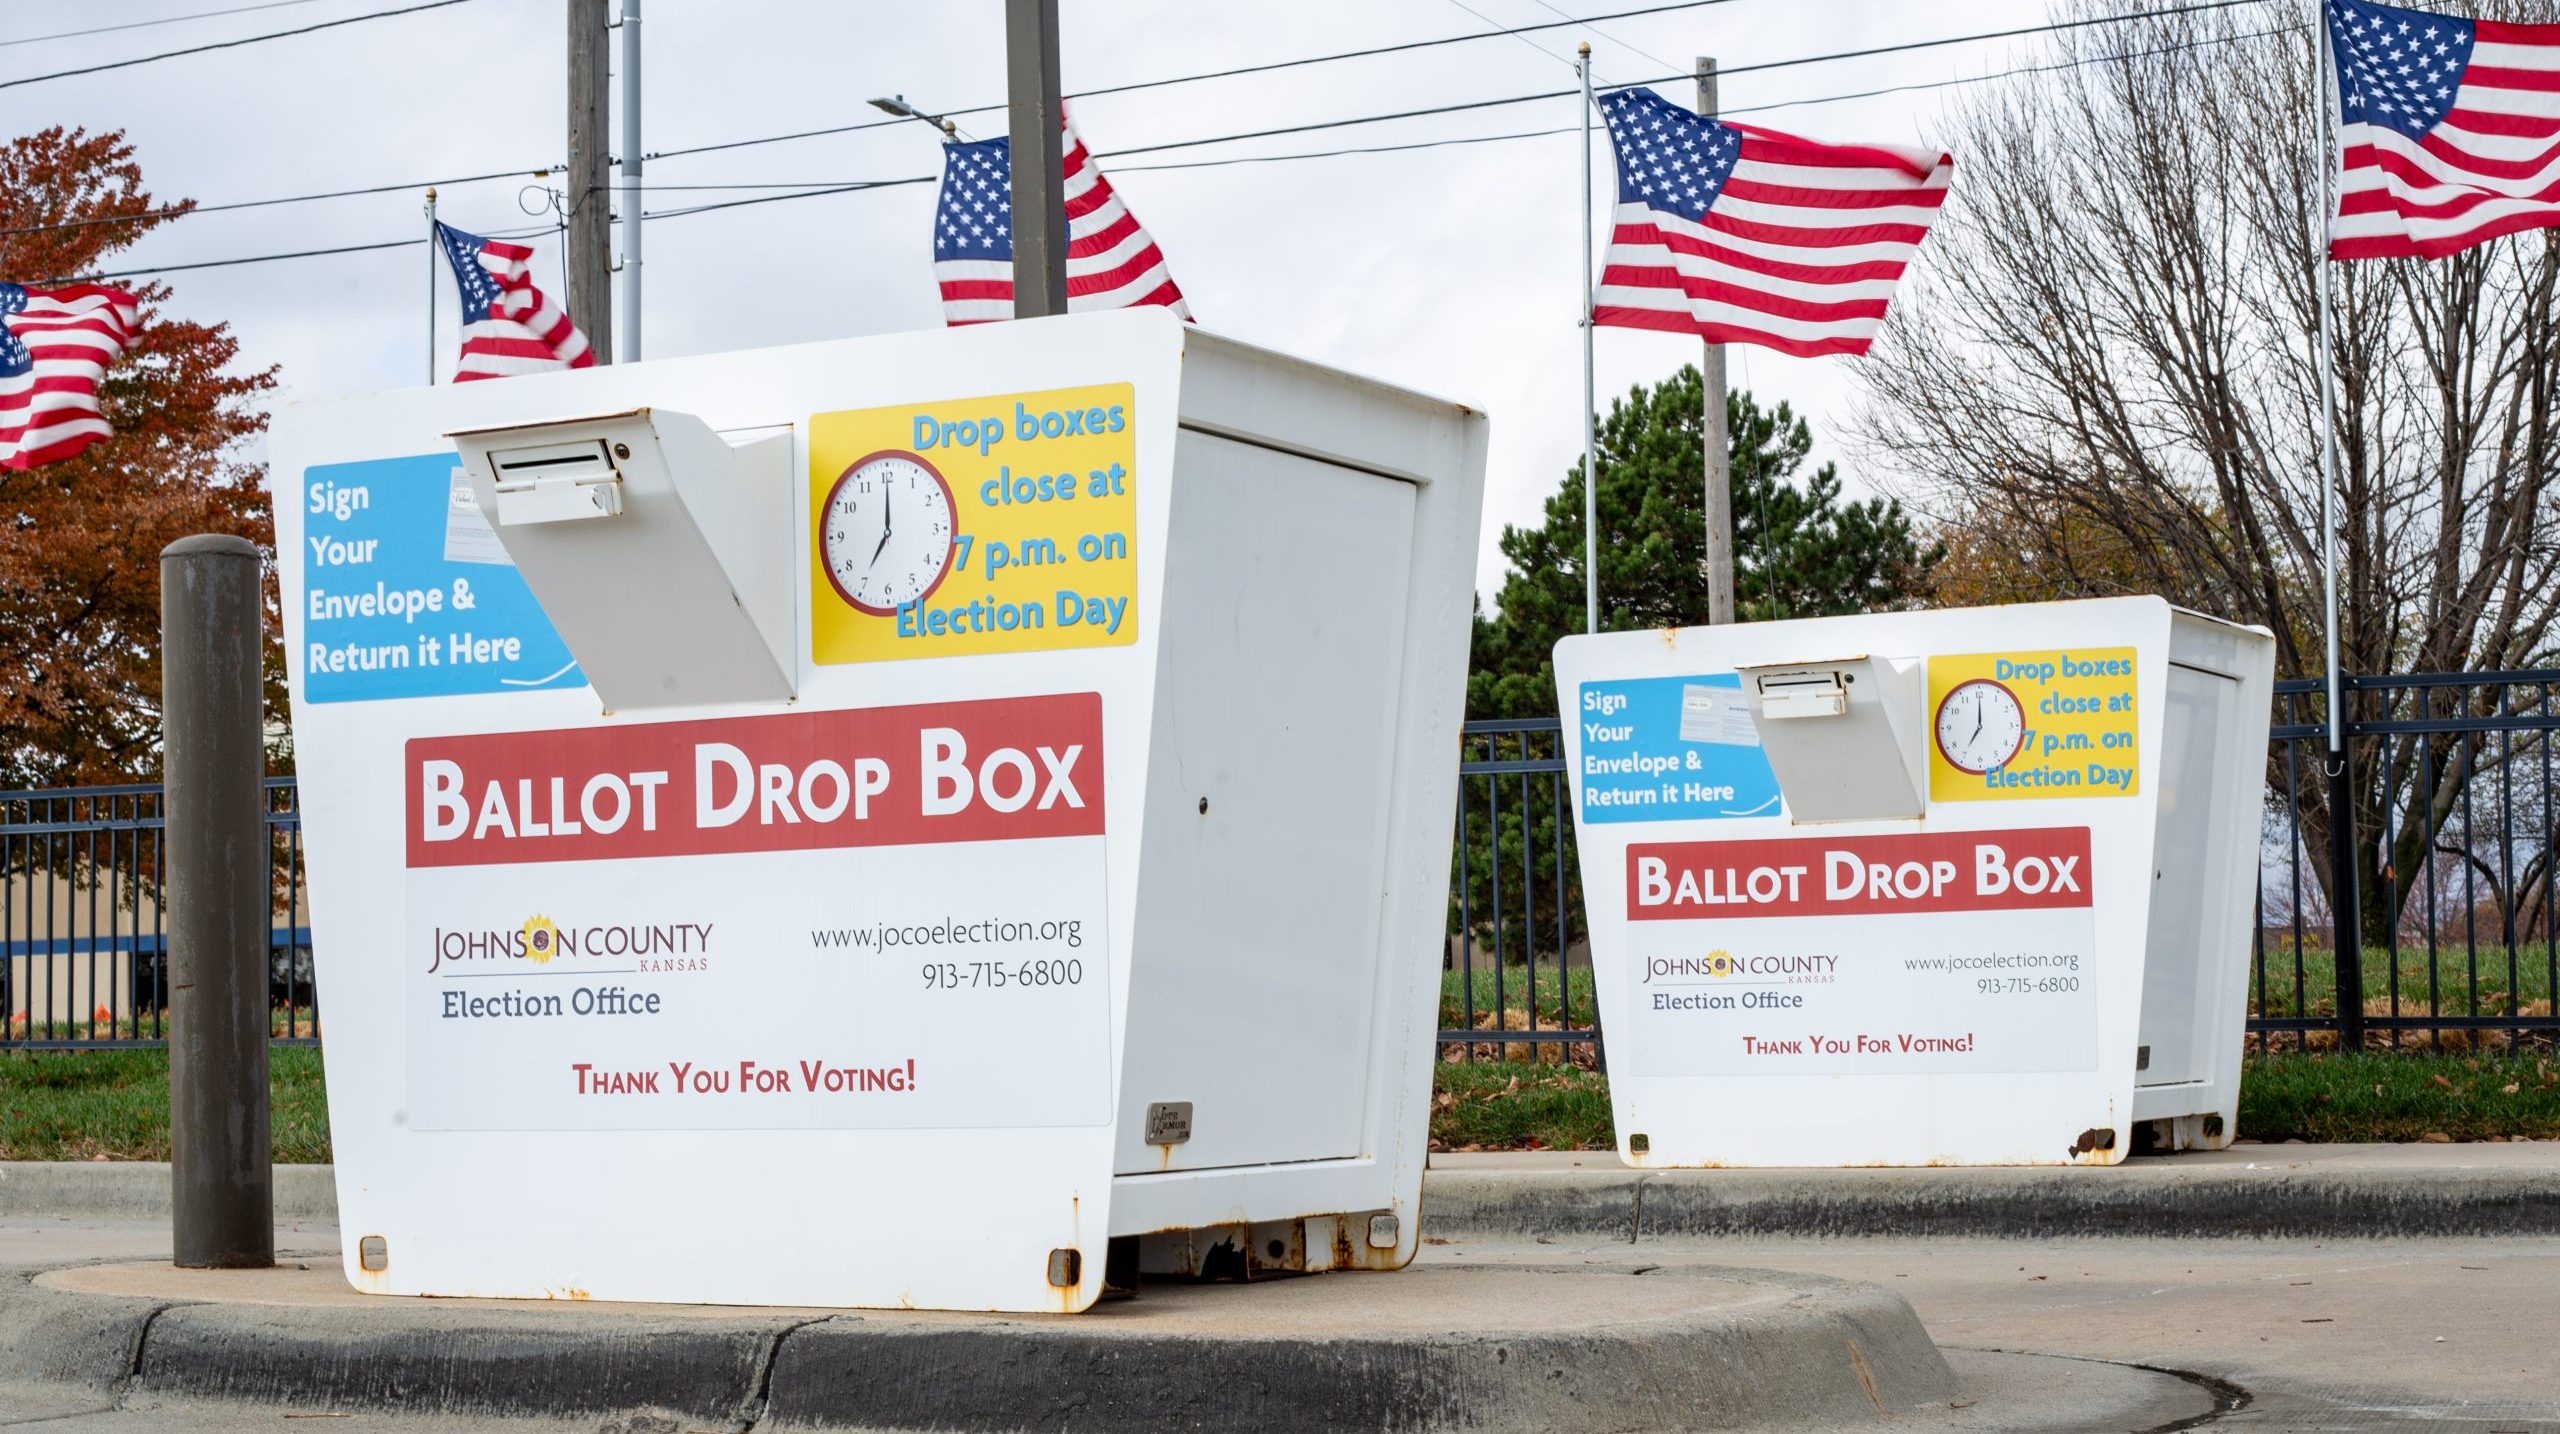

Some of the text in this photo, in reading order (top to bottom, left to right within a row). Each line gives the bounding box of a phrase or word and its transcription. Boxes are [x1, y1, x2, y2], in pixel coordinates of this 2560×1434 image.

[913, 402, 1125, 455] Drop boxes
[859, 481, 872, 494] 11
[880, 471, 894, 484] 12
[910, 477, 916, 489] 1
[980, 463, 1126, 506] close at
[309, 481, 369, 521] Sign
[843, 501, 857, 514] 10
[925, 495, 933, 507] 2
[837, 531, 845, 543] 9
[932, 523, 940, 535] 3
[309, 536, 377, 566] Your
[923, 553, 931, 565] 4
[953, 532, 1126, 581] 7 p.m. on
[845, 559, 853, 572] 8
[861, 577, 868, 590] 7
[884, 582, 892, 595] 6
[908, 573, 916, 586] 5
[309, 578, 475, 624] Envelope &
[897, 590, 1128, 638] Election Day
[310, 632, 521, 673] Return it Here
[1996, 655, 2131, 685] Drop boxes
[1584, 691, 1627, 715] Sign
[2040, 691, 2132, 714] close at
[1585, 723, 1633, 742] Your
[2022, 730, 2132, 756] 7 p.m. on
[1585, 750, 1702, 777] Envelope &
[423, 727, 1085, 842] BALLOT DROP BOX
[1986, 764, 2132, 790] Election Day
[1586, 783, 1734, 806] Return it Here
[1638, 844, 2081, 906] BALLOT DROP BOX
[811, 916, 1082, 954] www.jocoelection.org
[428, 923, 713, 974] JOHNSON COUNTY
[640, 958, 708, 972] KANSAS
[923, 959, 1082, 989] 913-715-6800
[1643, 955, 1839, 984] JOHNSON COUNTY
[1905, 952, 2079, 974] www.jocoelection.org
[1788, 975, 1835, 984] KANSAS
[1977, 976, 2079, 994] 913-715-6800
[442, 986, 661, 1018] Election Office
[1653, 992, 1803, 1010] Election Office
[1743, 1033, 1973, 1055] THANK YOU FOR VOTING!
[572, 1059, 915, 1094] THANK YOU FOR VOTING!
